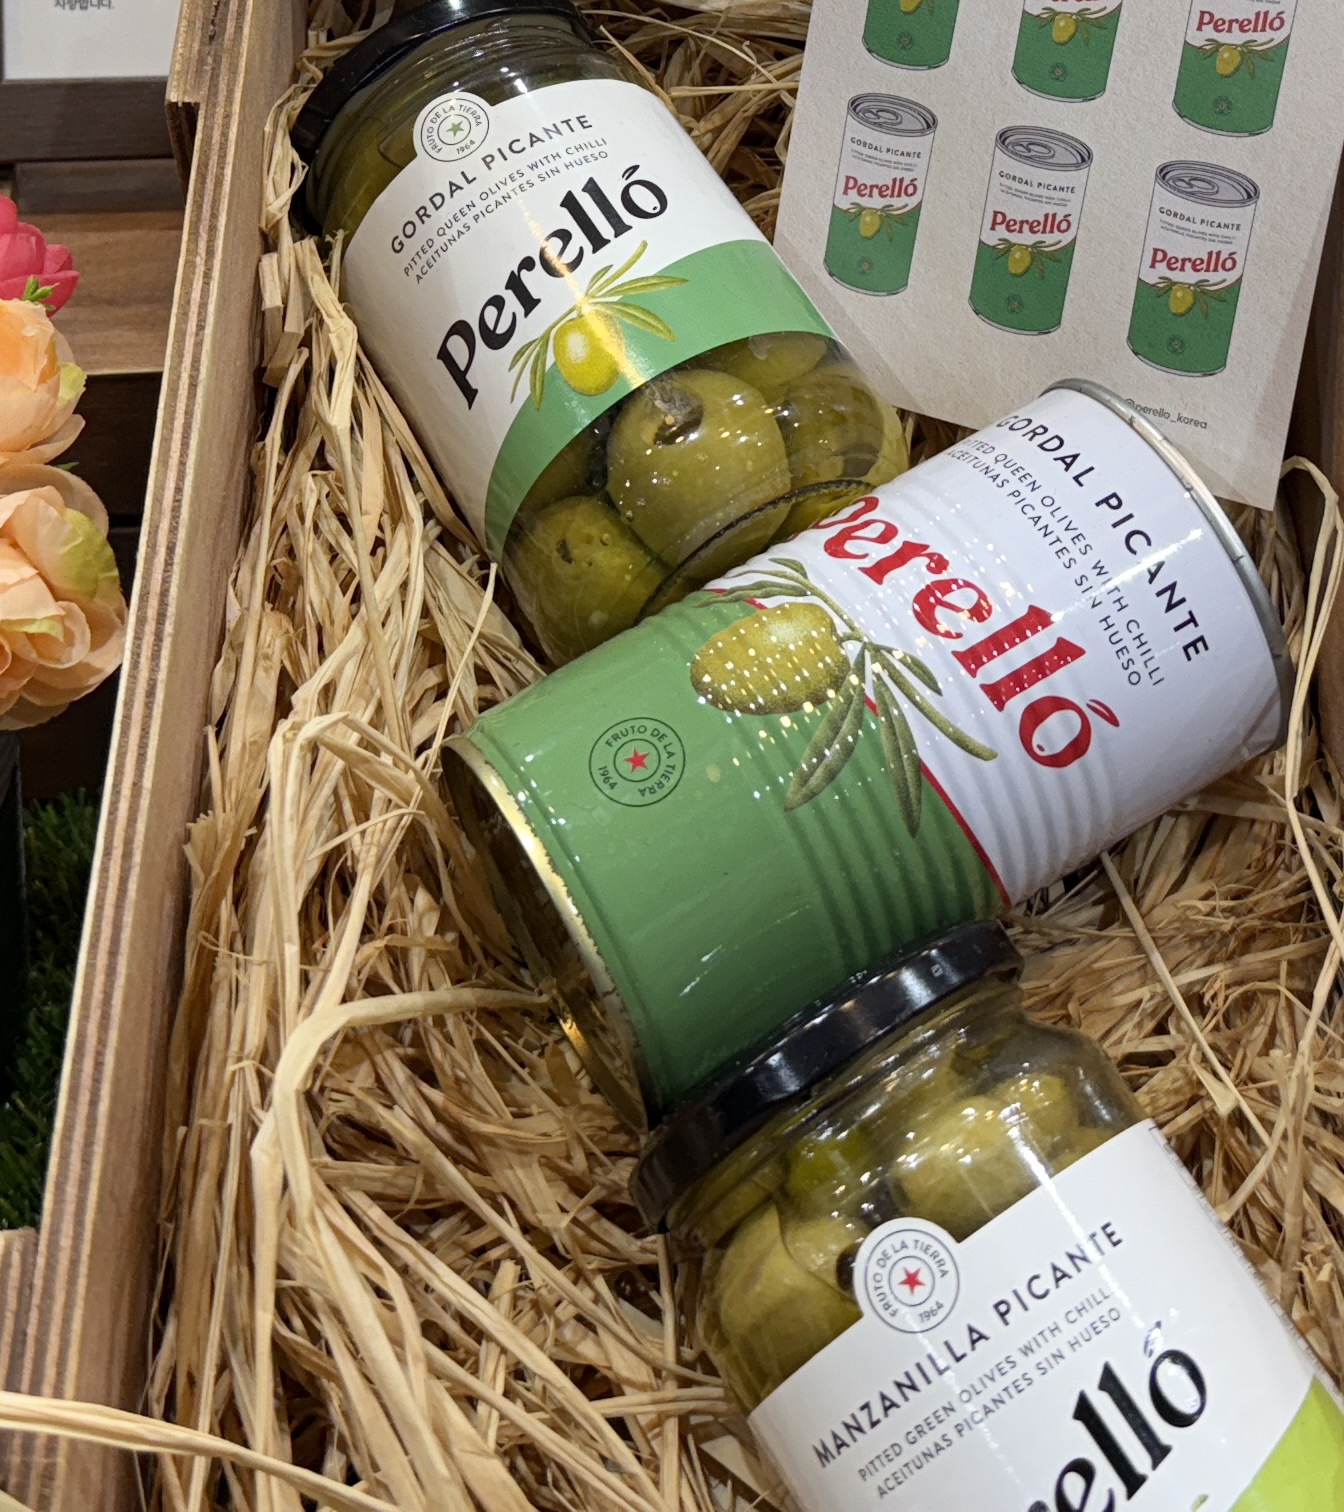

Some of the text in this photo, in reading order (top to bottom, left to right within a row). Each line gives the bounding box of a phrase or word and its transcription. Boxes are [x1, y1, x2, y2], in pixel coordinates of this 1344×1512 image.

[1196, 10, 1285, 34] Perelló
[390, 112, 594, 256] GORDAL PICANTE
[403, 138, 608, 278] PITTED QUEEN OLIVES WITH CHILLI
[414, 149, 609, 284] ACEITUNAS PICANTES SIN HUESO
[842, 175, 918, 199] Perelló
[989, 209, 1072, 235] Perelló
[437, 164, 669, 410] Perelló
[1149, 247, 1237, 274] Perelló
[993, 453, 1166, 688] QUEEN OLIVES WITH CHILLI
[995, 414, 1209, 663] GORDAL PICANTE
[1007, 499, 1142, 687] PICANTES HUESO
[812, 1220, 1125, 1469] MANZANILLA PICANTE
[857, 1328, 1065, 1482] PITTED GREEN OLIVES WITH
[877, 1307, 1123, 1499] ACEITUNAS PICANTES HUESO
